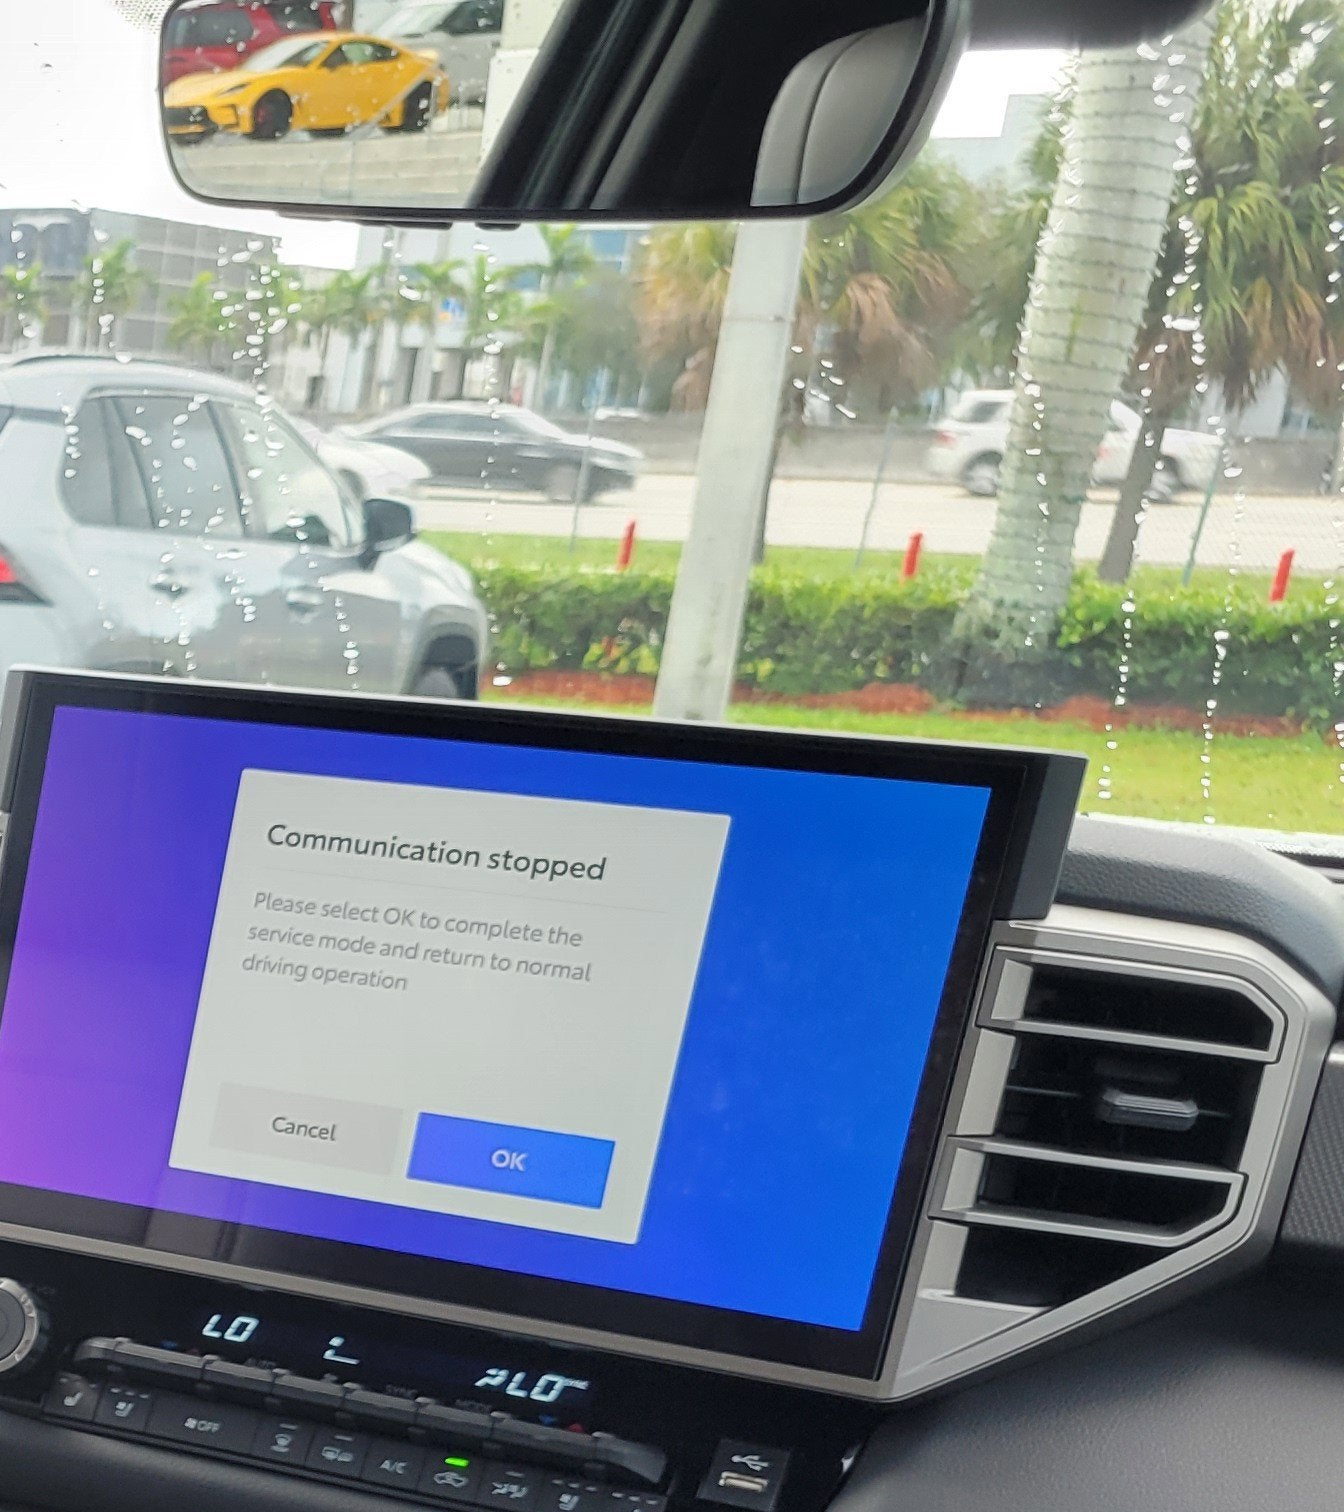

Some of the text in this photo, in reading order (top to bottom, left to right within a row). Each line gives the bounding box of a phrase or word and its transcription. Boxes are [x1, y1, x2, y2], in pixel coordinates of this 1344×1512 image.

[266, 823, 608, 882] Communication stopped
[253, 891, 583, 948] Please select OK to complete the
[247, 925, 593, 983] service mode and return to normal
[242, 953, 408, 992] driving operation
[271, 1116, 337, 1142] Cancel
[490, 1149, 530, 1172] OK
[201, 1313, 260, 1343] LO
[379, 1458, 408, 1475] A/C
